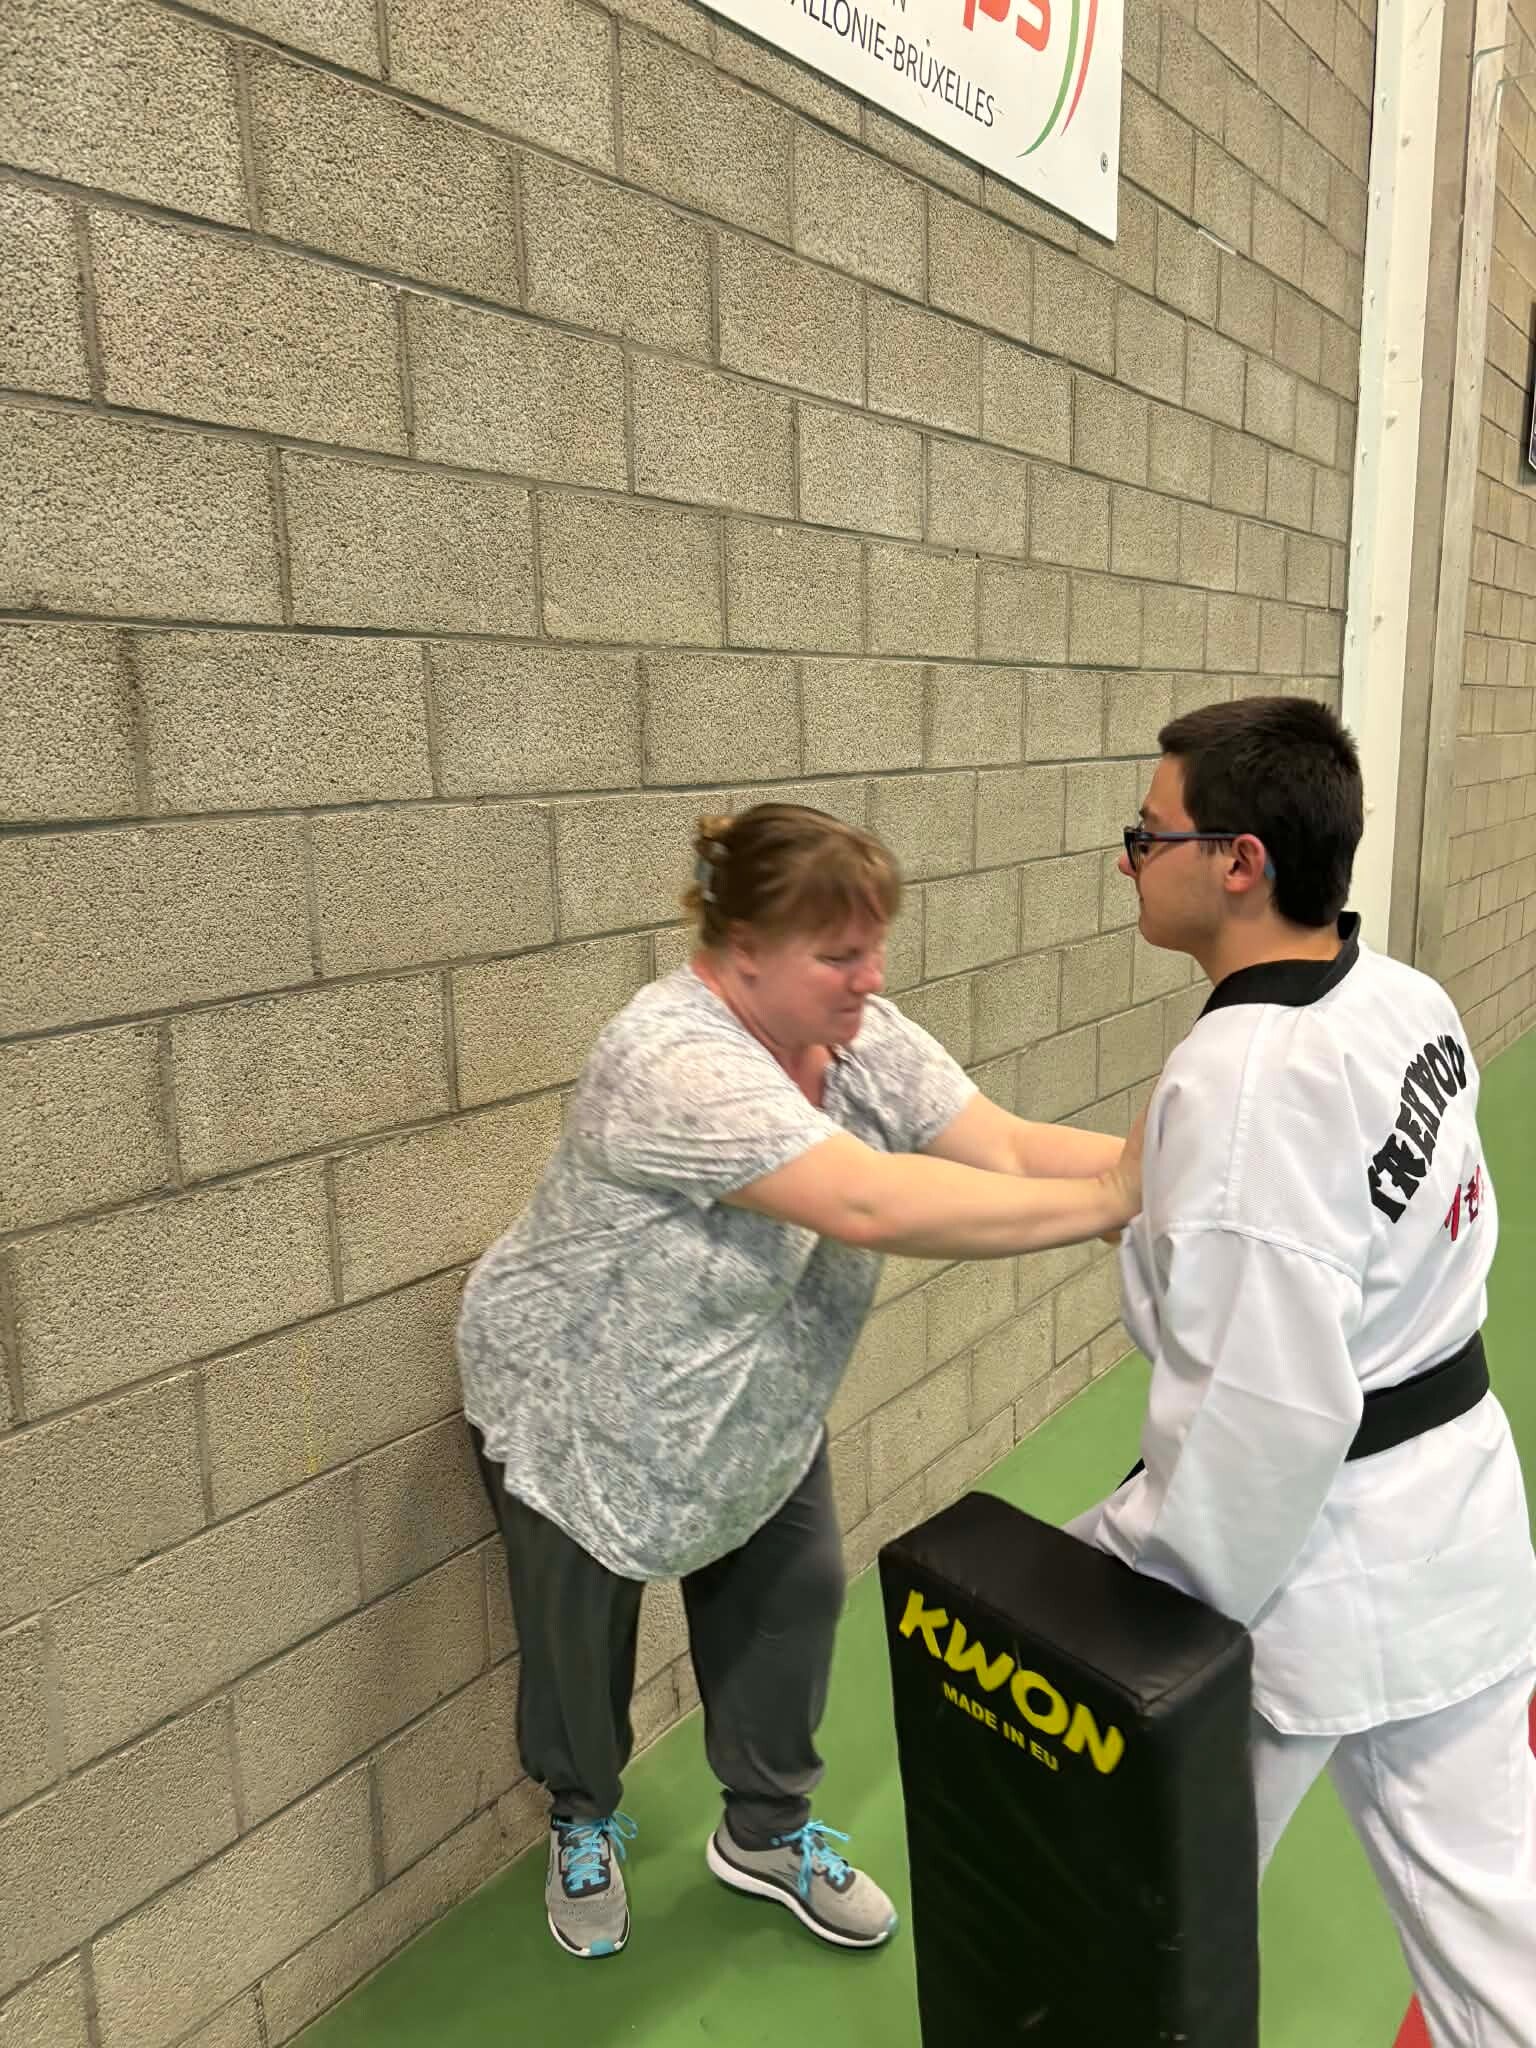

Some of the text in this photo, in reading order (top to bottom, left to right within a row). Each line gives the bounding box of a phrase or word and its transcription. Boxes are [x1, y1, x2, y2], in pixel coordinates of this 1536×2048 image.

[899, 1589, 1125, 1774] KWON
[942, 1681, 1059, 1771] MADE IN EU
